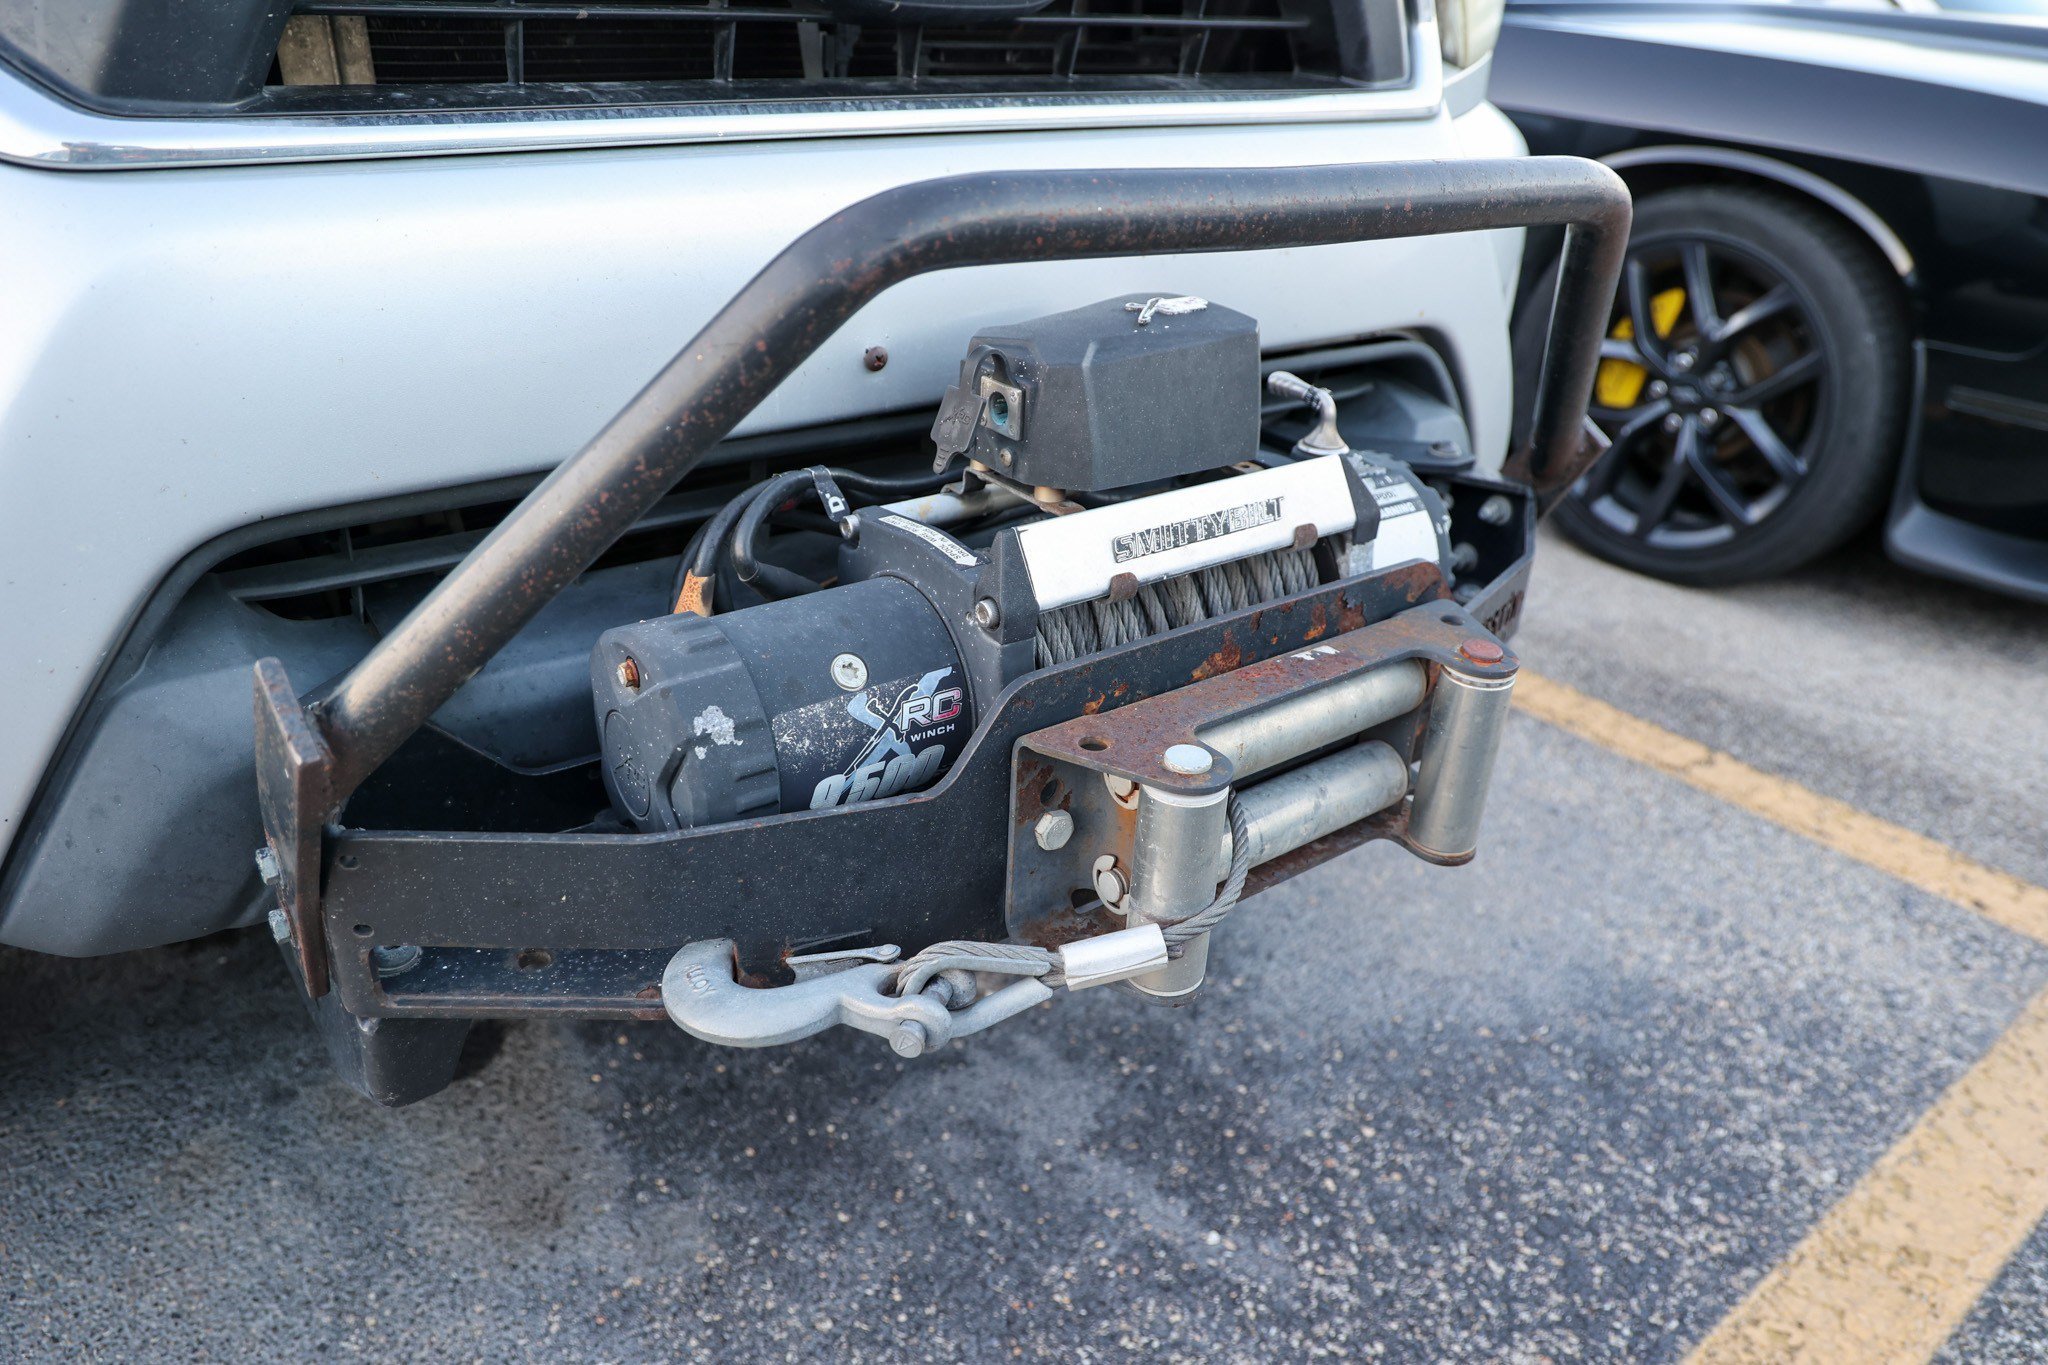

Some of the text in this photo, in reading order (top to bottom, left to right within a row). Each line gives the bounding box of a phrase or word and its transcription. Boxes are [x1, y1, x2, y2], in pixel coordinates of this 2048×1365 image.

[1111, 495, 1286, 564] SMITTYBILT
[842, 666, 963, 777] XRC
[910, 723, 956, 743] WINCH
